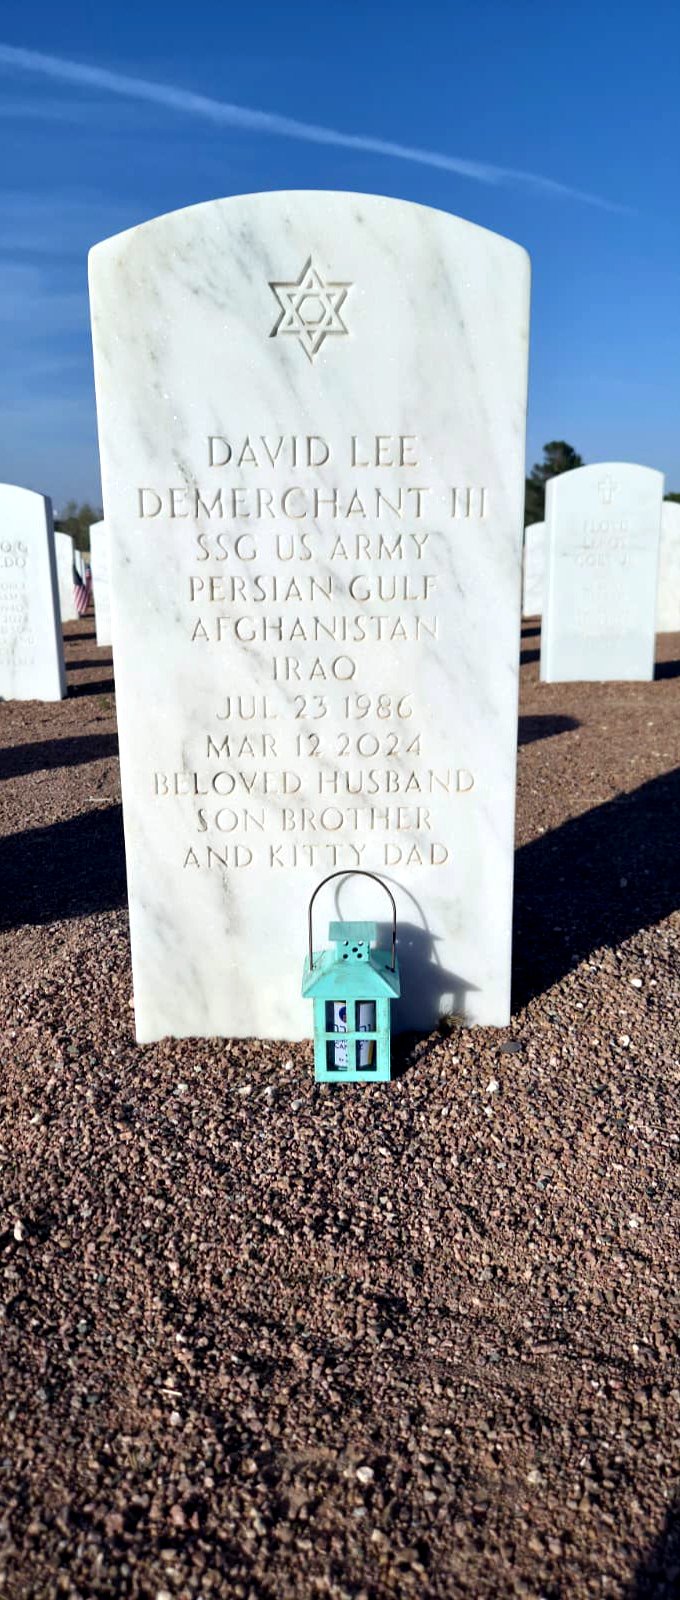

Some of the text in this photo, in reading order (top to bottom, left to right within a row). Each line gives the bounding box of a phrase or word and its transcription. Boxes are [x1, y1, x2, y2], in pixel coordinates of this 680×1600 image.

[207, 435, 418, 468] DAVID LEE
[137, 487, 488, 519] DEMERCHANT III
[196, 533, 430, 561] SSG US ARMY
[189, 575, 438, 602] PERSIAN GULF
[190, 615, 438, 642] AFGHANISTAN
[216, 693, 414, 720] JUL 23 1986
[206, 732, 422, 758] MAR 12 2024
[153, 769, 475, 796] BELOVED HUSBAND
[196, 806, 432, 833] SON BROTHER
[183, 842, 449, 869] AND KITTY DAD
